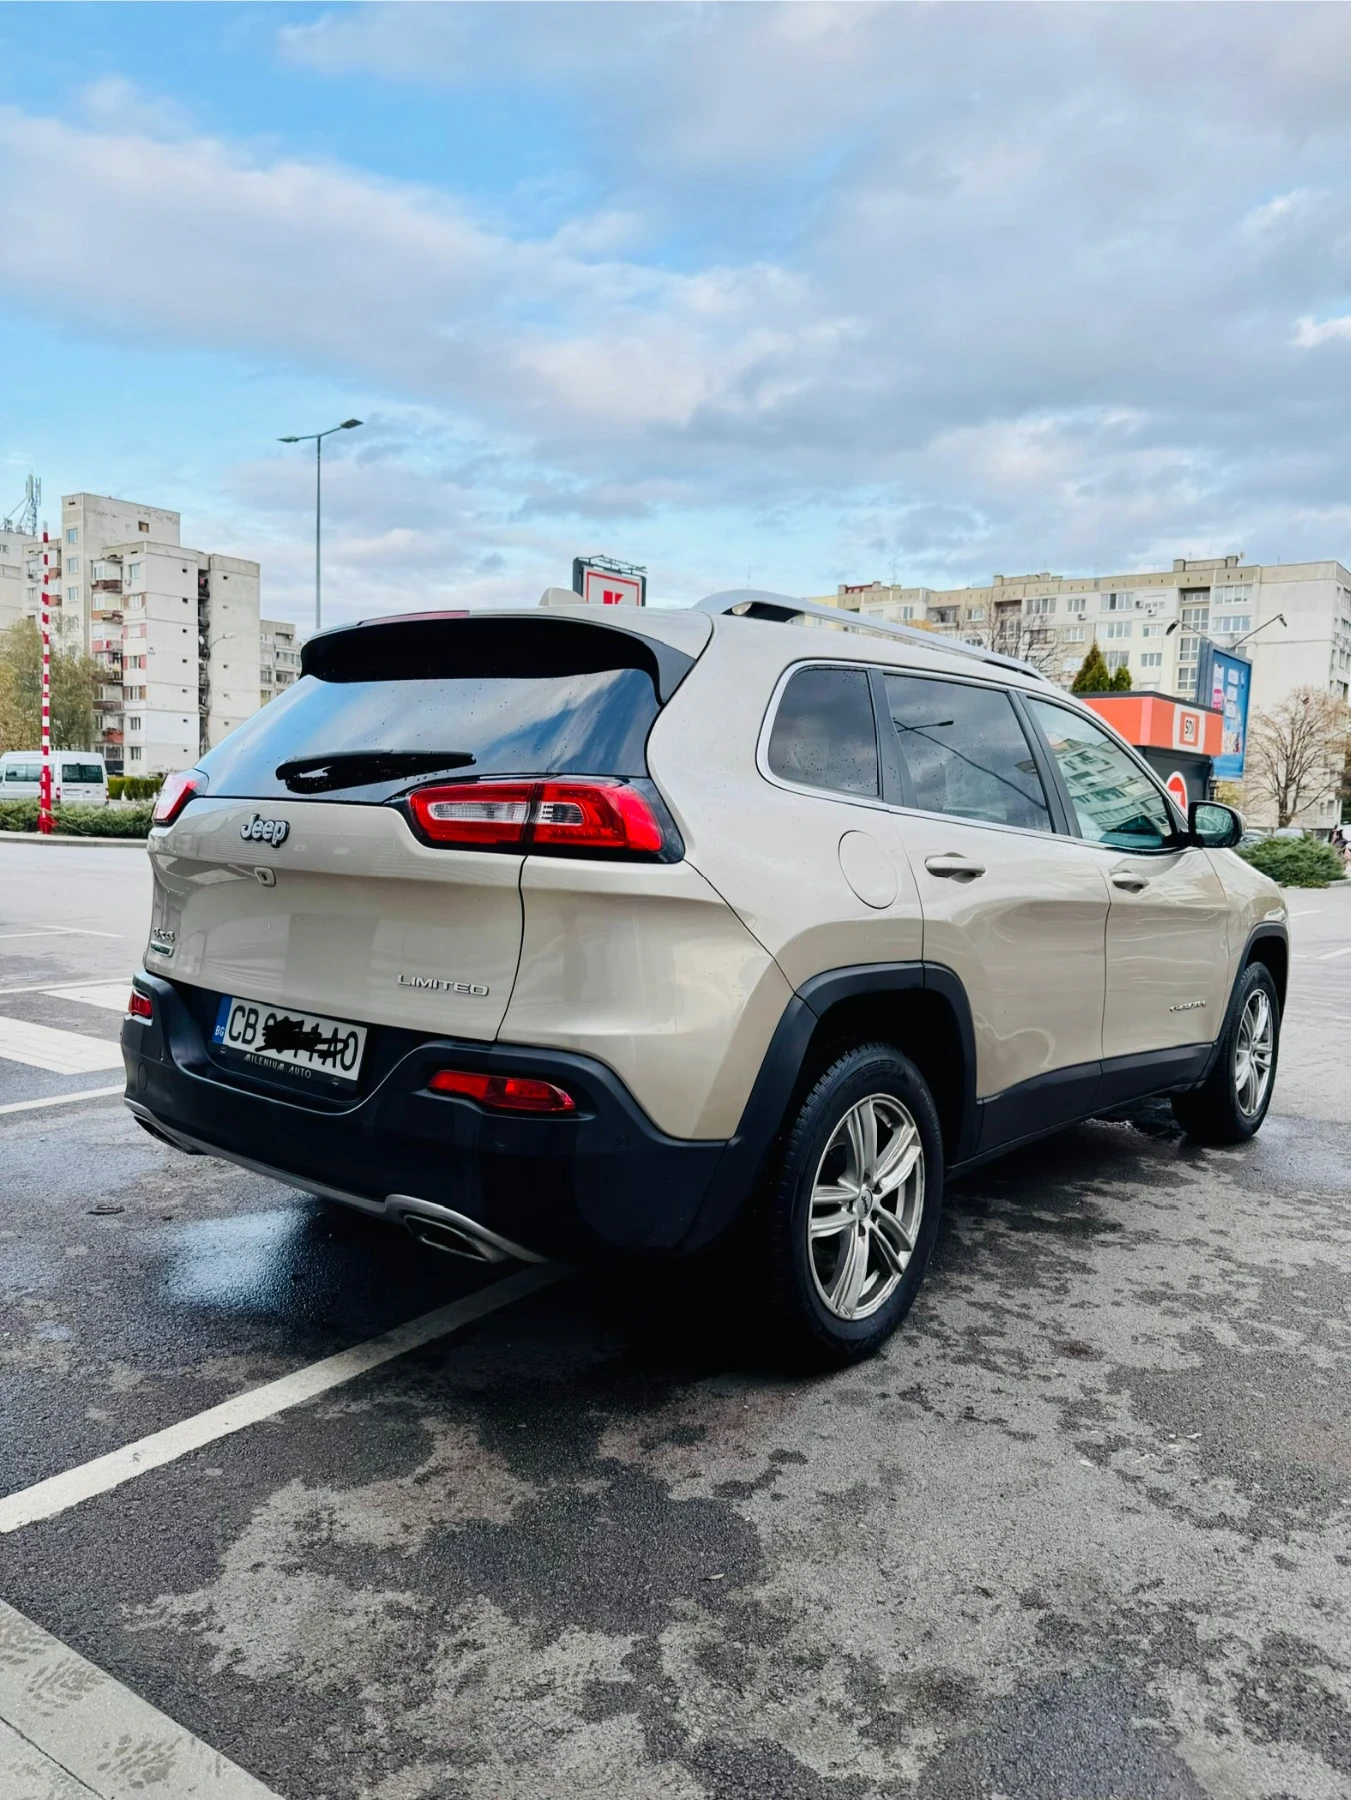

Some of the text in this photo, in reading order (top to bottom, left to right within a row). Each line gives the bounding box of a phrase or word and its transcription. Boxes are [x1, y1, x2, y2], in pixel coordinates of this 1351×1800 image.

[241, 813, 289, 848] Jeep
[397, 975, 489, 997] LIMITED
[215, 1025, 225, 1037] BG
[244, 1053, 312, 1079] MILENIUM AUTO
